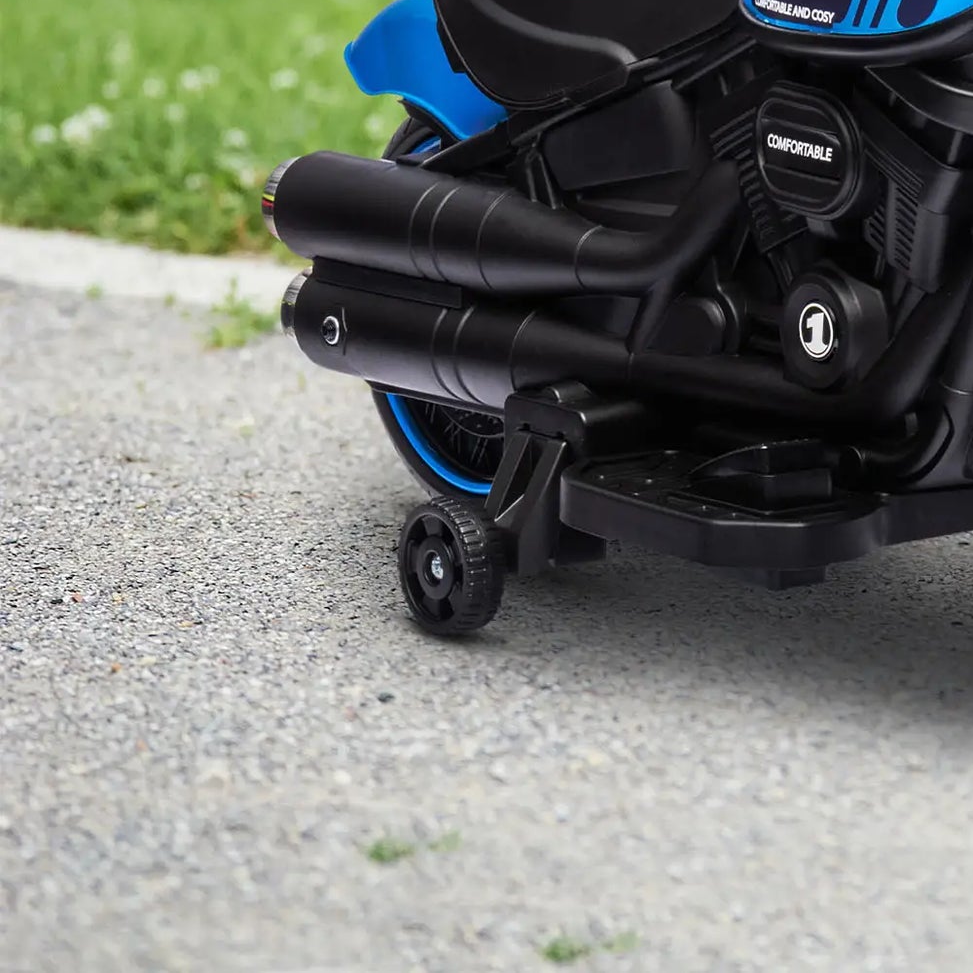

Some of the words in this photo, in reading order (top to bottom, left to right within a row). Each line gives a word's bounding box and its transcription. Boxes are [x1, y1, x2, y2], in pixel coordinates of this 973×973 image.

[793, 5, 811, 20] AND
[811, 8, 835, 24] COSY
[767, 132, 833, 163] COMFORTABLE
[804, 312, 828, 353] 1
